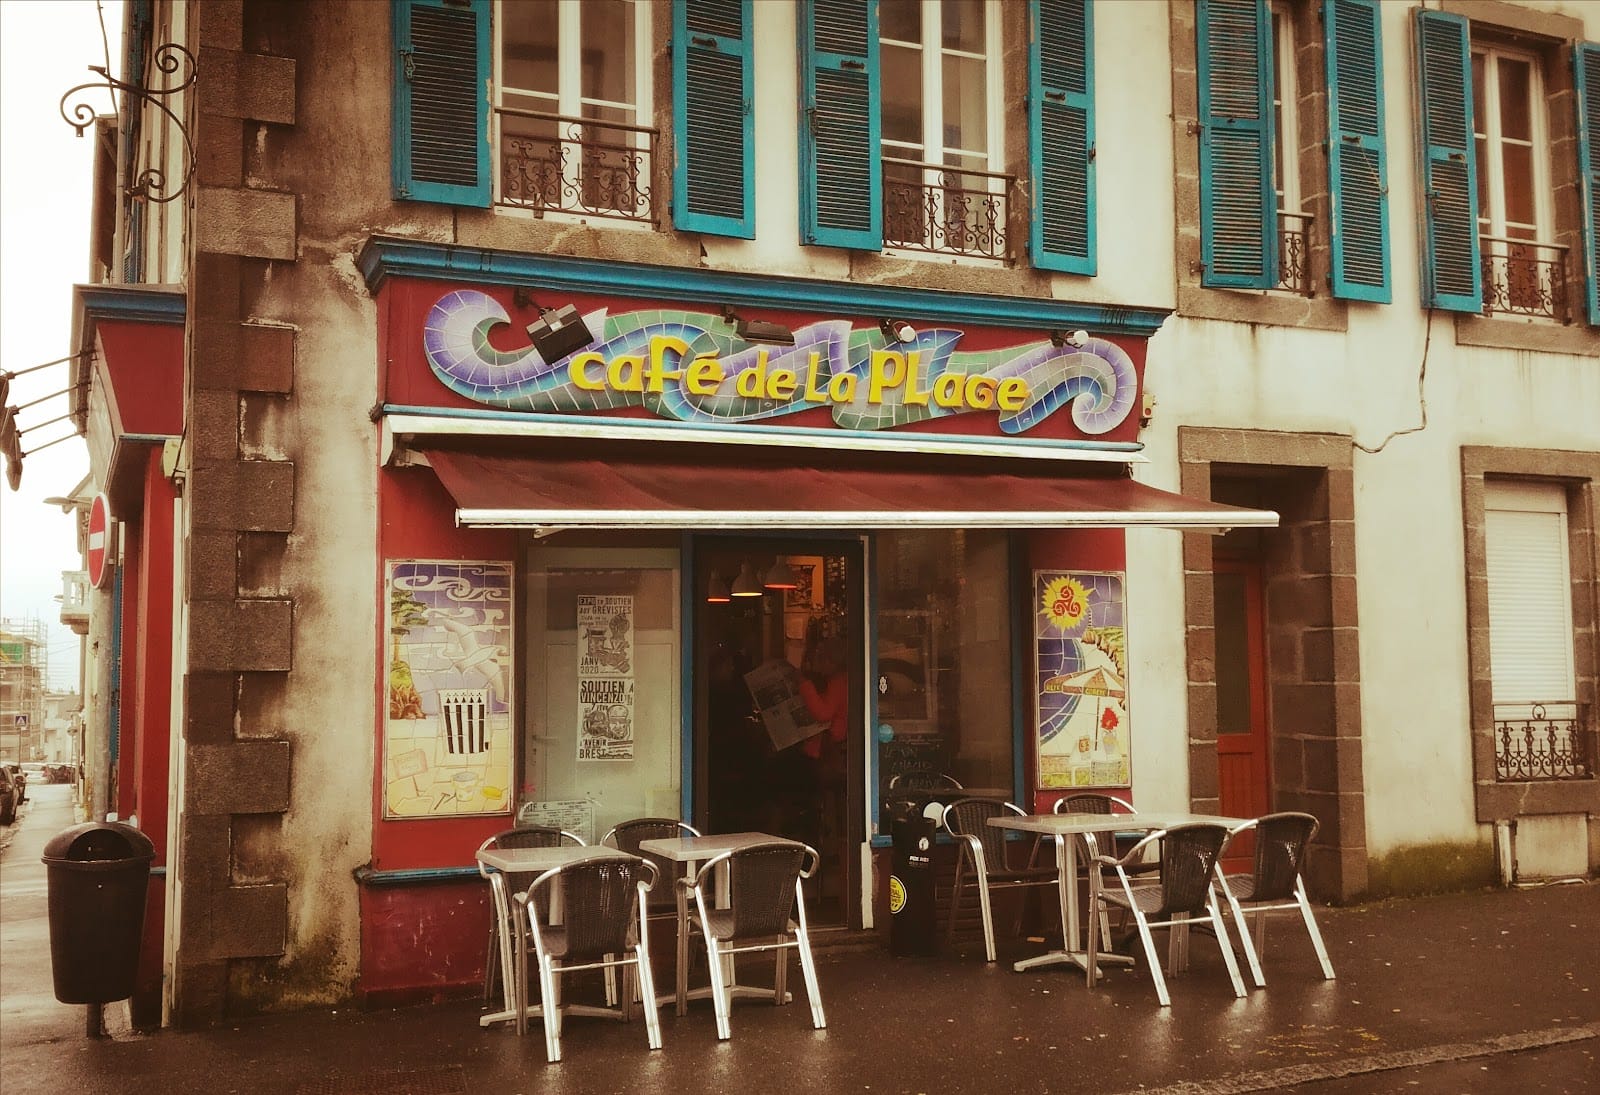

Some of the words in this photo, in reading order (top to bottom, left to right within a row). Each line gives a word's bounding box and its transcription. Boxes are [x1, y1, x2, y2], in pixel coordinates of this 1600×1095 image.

[736, 350, 798, 400] de
[580, 656, 599, 666] JANV
[580, 666, 598, 674] 2020
[581, 680, 625, 693] SOUTIEN
[581, 692, 625, 703] VINCENZO
[579, 748, 606, 759] BREST
